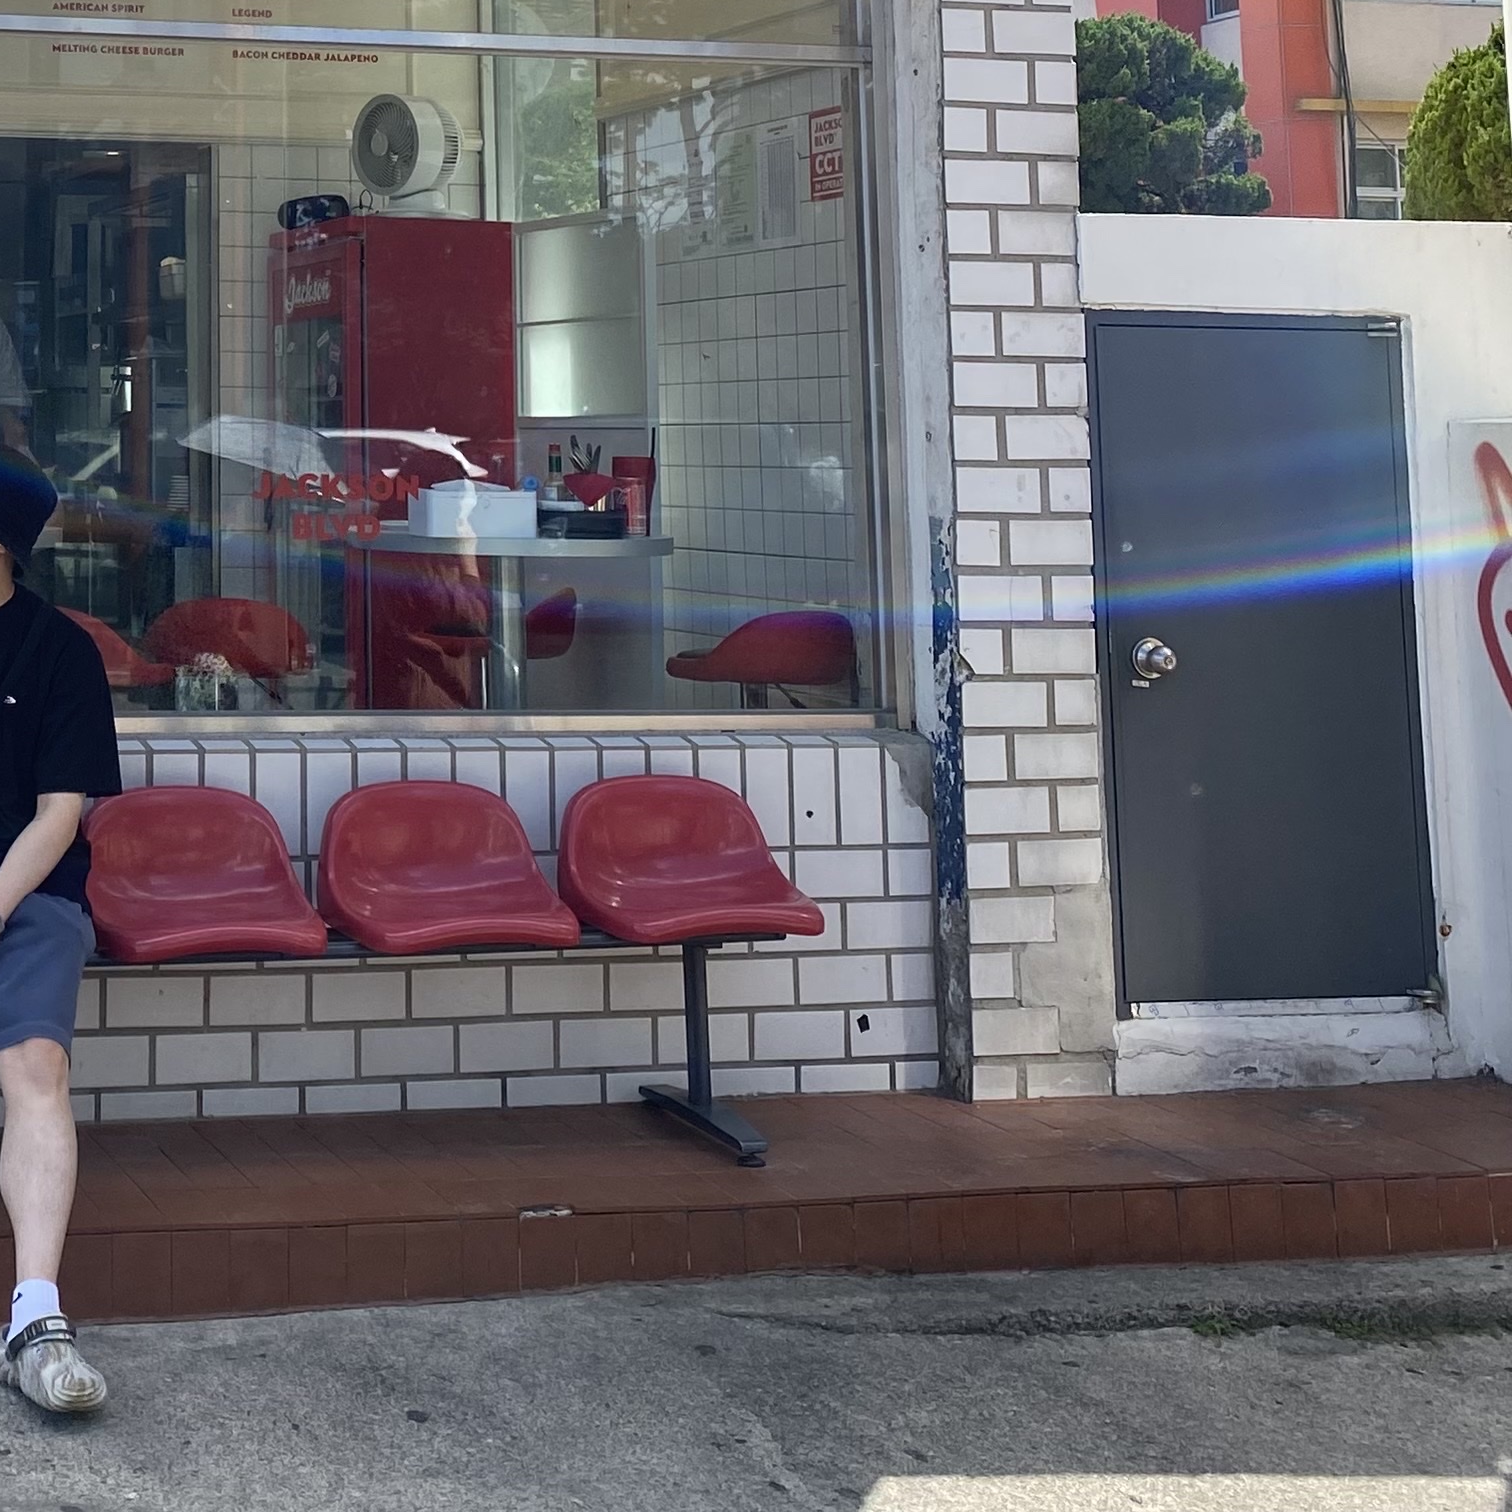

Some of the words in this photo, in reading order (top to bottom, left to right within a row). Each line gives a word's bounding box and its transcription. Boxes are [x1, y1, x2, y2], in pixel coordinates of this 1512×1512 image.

[52, 2, 109, 12] AMERICAN
[111, 4, 146, 13] SPIRIT
[232, 8, 273, 19] LEGEND
[52, 44, 98, 54] MELTING
[100, 45, 140, 55] CHEESE
[142, 47, 184, 57] BURGER
[232, 50, 269, 60] BACON
[271, 51, 321, 61] CHEDDAR
[324, 53, 379, 63] JALAPENO
[252, 472, 420, 501] JACKSON
[291, 512, 381, 542] BLVD
